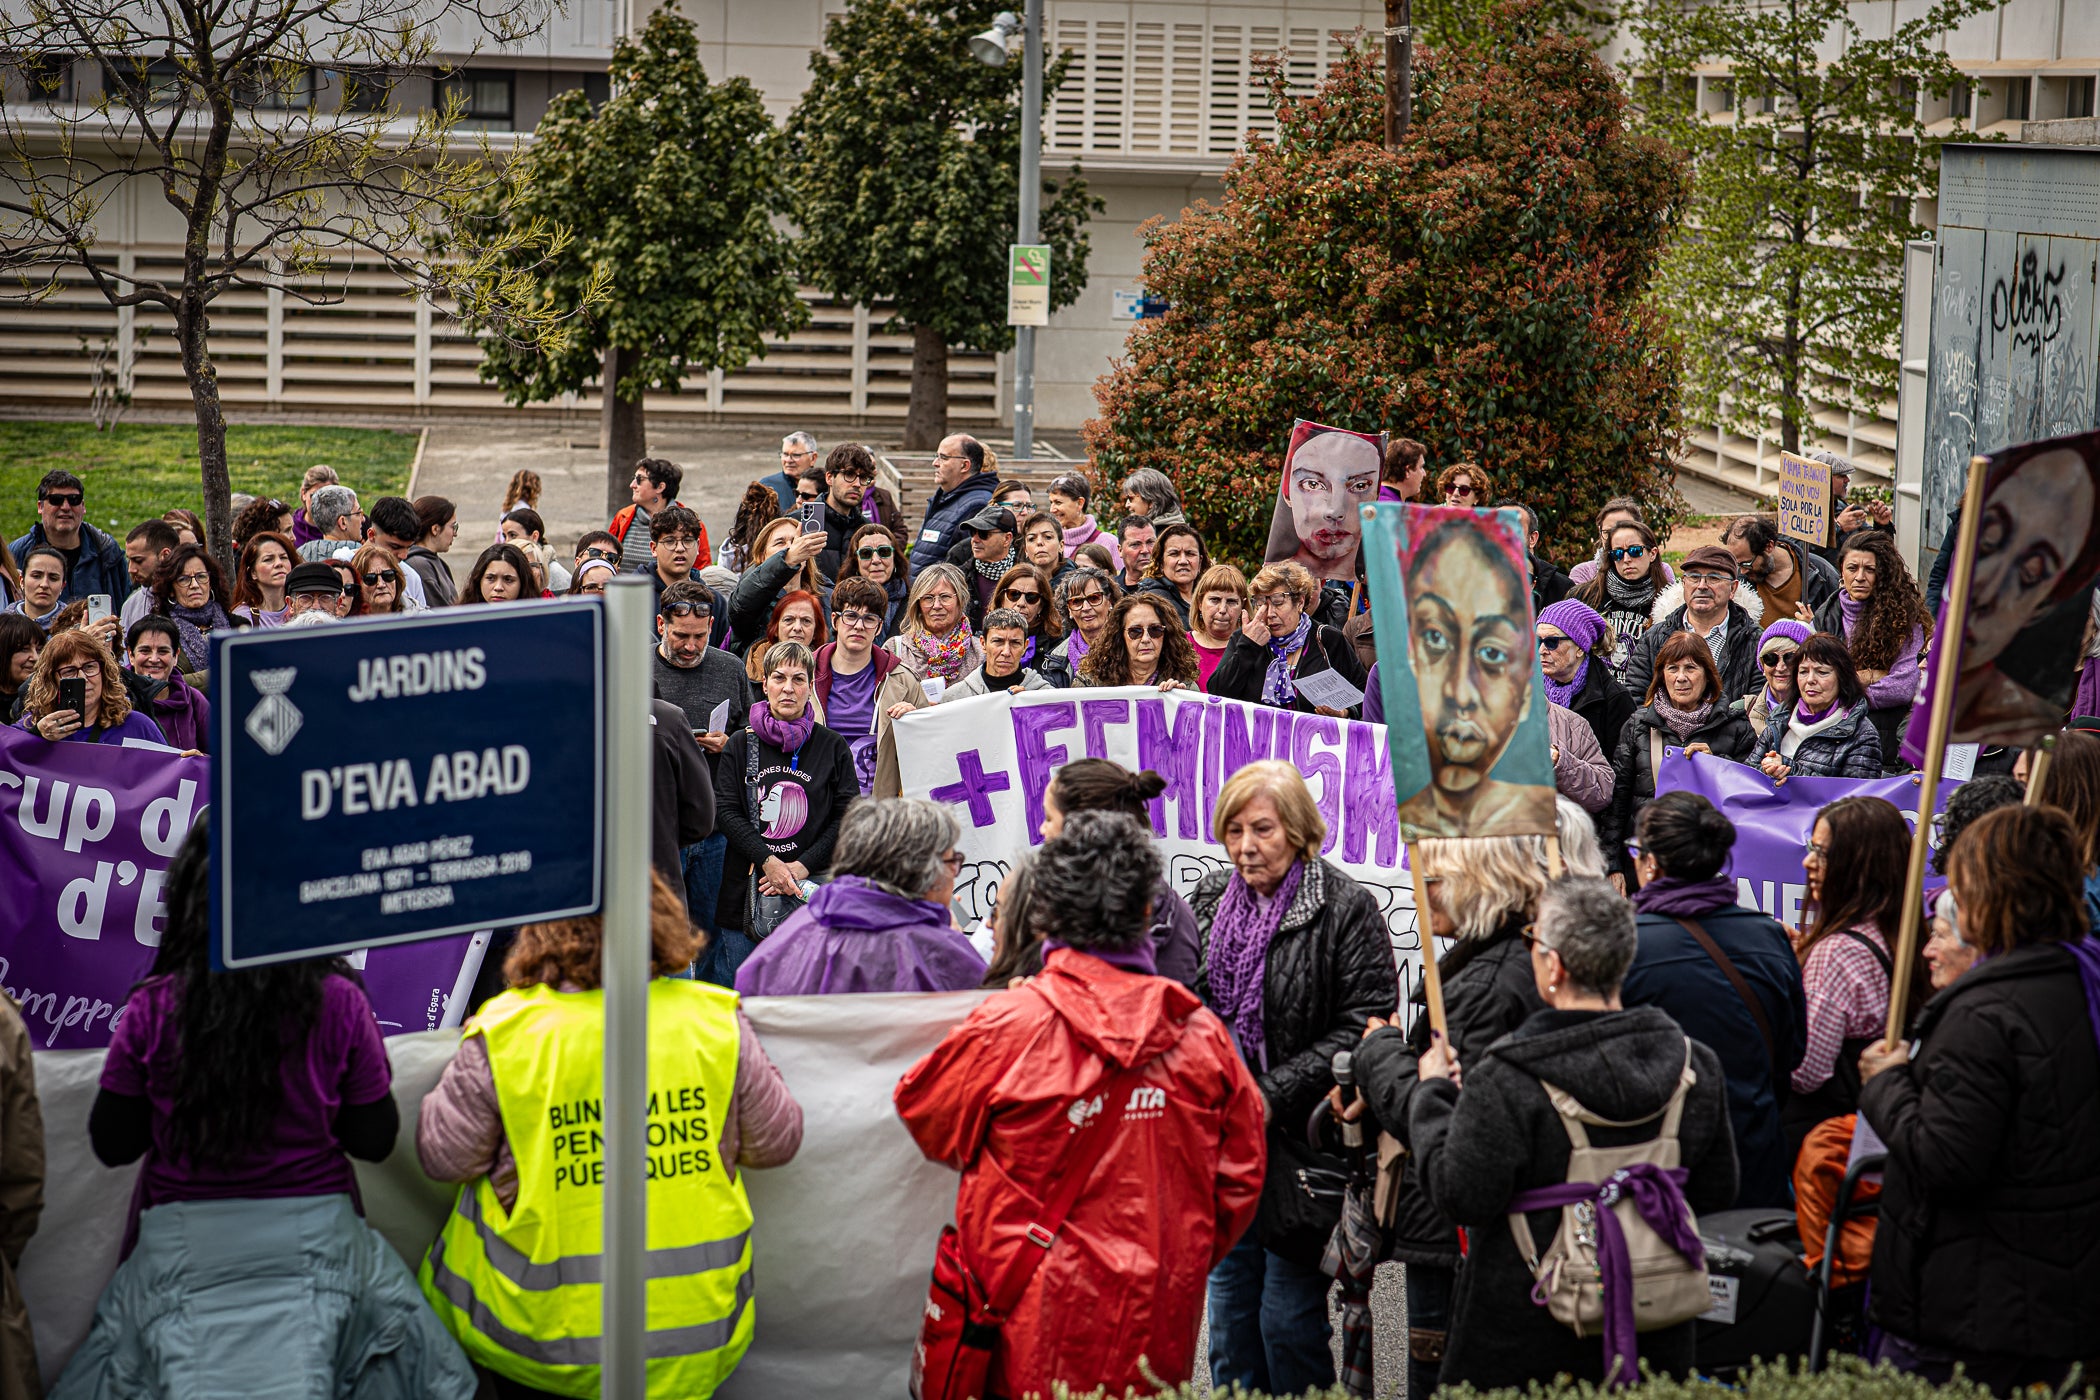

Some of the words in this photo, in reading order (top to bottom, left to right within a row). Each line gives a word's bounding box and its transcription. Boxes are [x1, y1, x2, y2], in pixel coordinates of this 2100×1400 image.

[1780, 496, 1798, 511] SOLA
[1801, 501, 1813, 516] POR
[1814, 504, 1822, 518] LA
[1796, 484, 1804, 498] NO
[1806, 486, 1820, 499] VOY
[1791, 515, 1814, 534] CALLE
[347, 647, 487, 702] JARDINS
[301, 758, 418, 821] D'EVA
[425, 745, 530, 804] ABAD
[427, 988, 440, 1021] d'Egara
[549, 1091, 659, 1129] BLINM
[666, 1087, 706, 1114] LES
[554, 1118, 708, 1161] PENONS
[555, 1149, 711, 1192] PÚQUES
